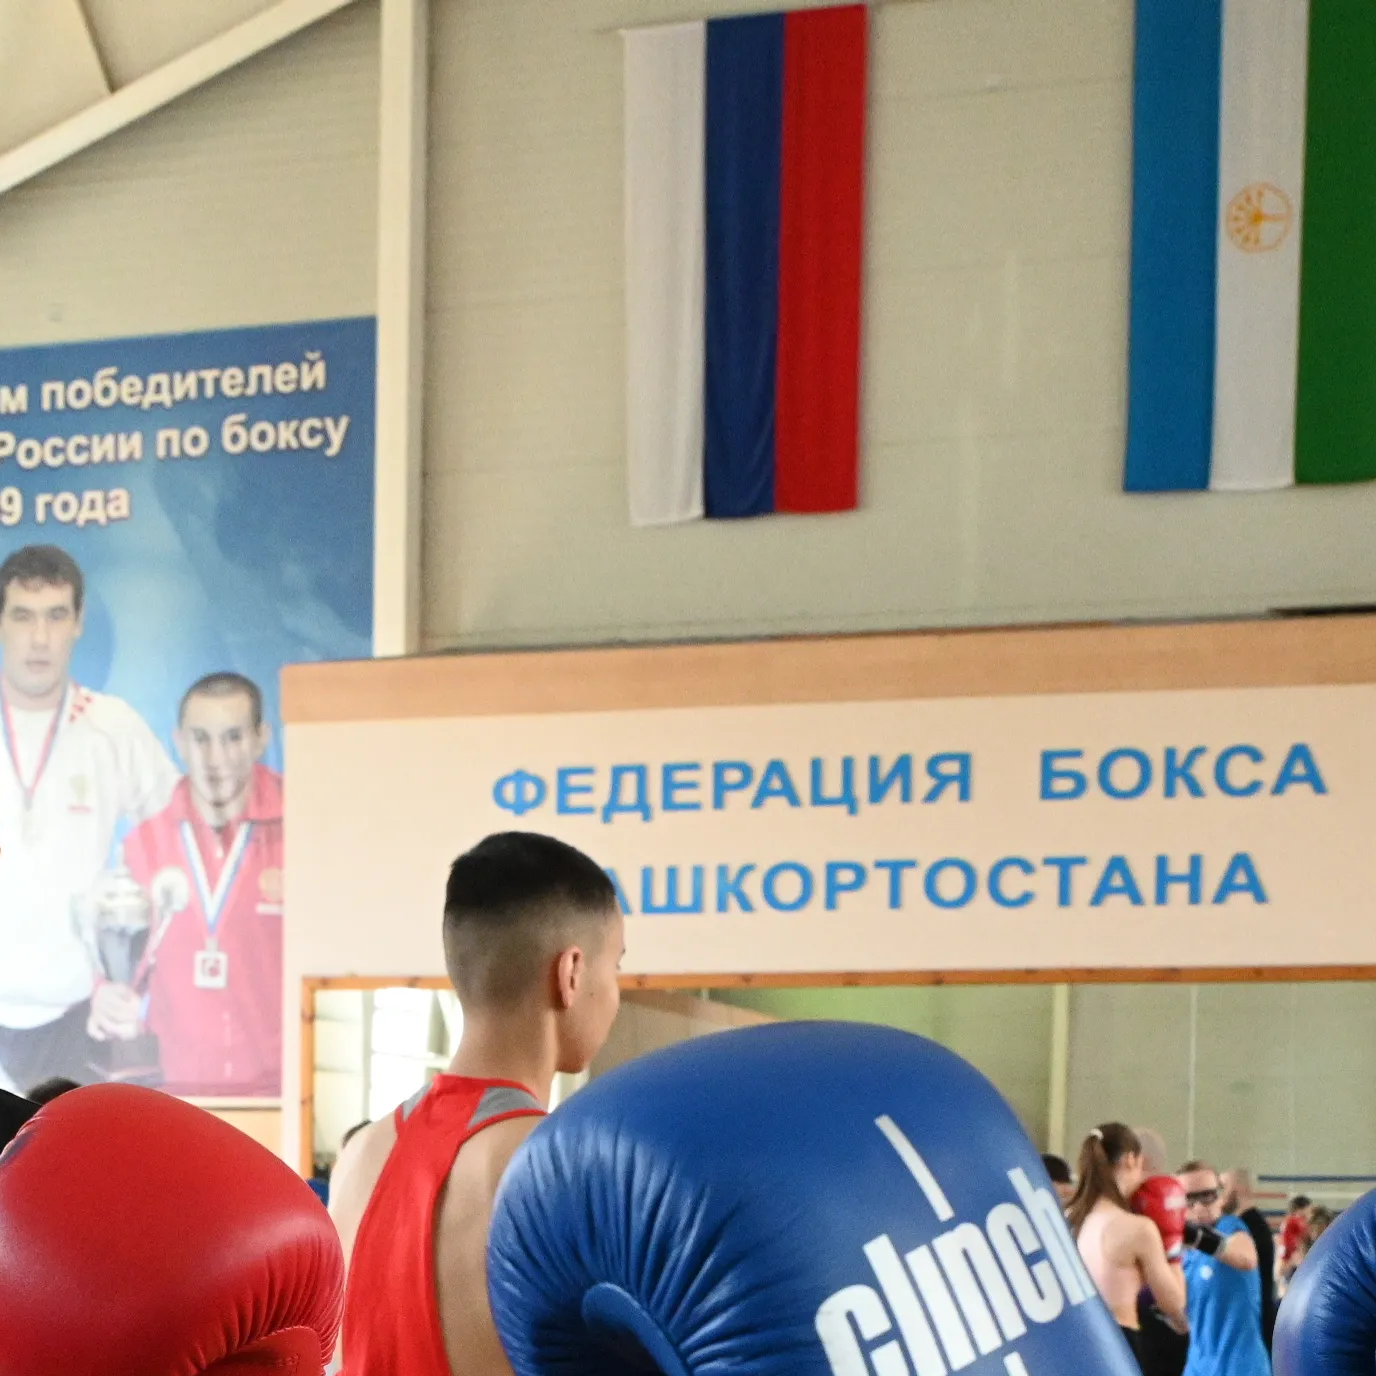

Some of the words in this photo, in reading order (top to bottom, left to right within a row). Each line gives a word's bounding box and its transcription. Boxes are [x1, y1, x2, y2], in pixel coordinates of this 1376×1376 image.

[40, 350, 327, 411] победителей
[155, 425, 210, 460] по
[221, 412, 350, 458] боксу
[35, 488, 131, 528] года
[492, 752, 973, 823] ФЕДЕРАЦИЯ
[1039, 742, 1328, 801] БОКСА
[602, 852, 1269, 916] ШКОРТОСТАНА
